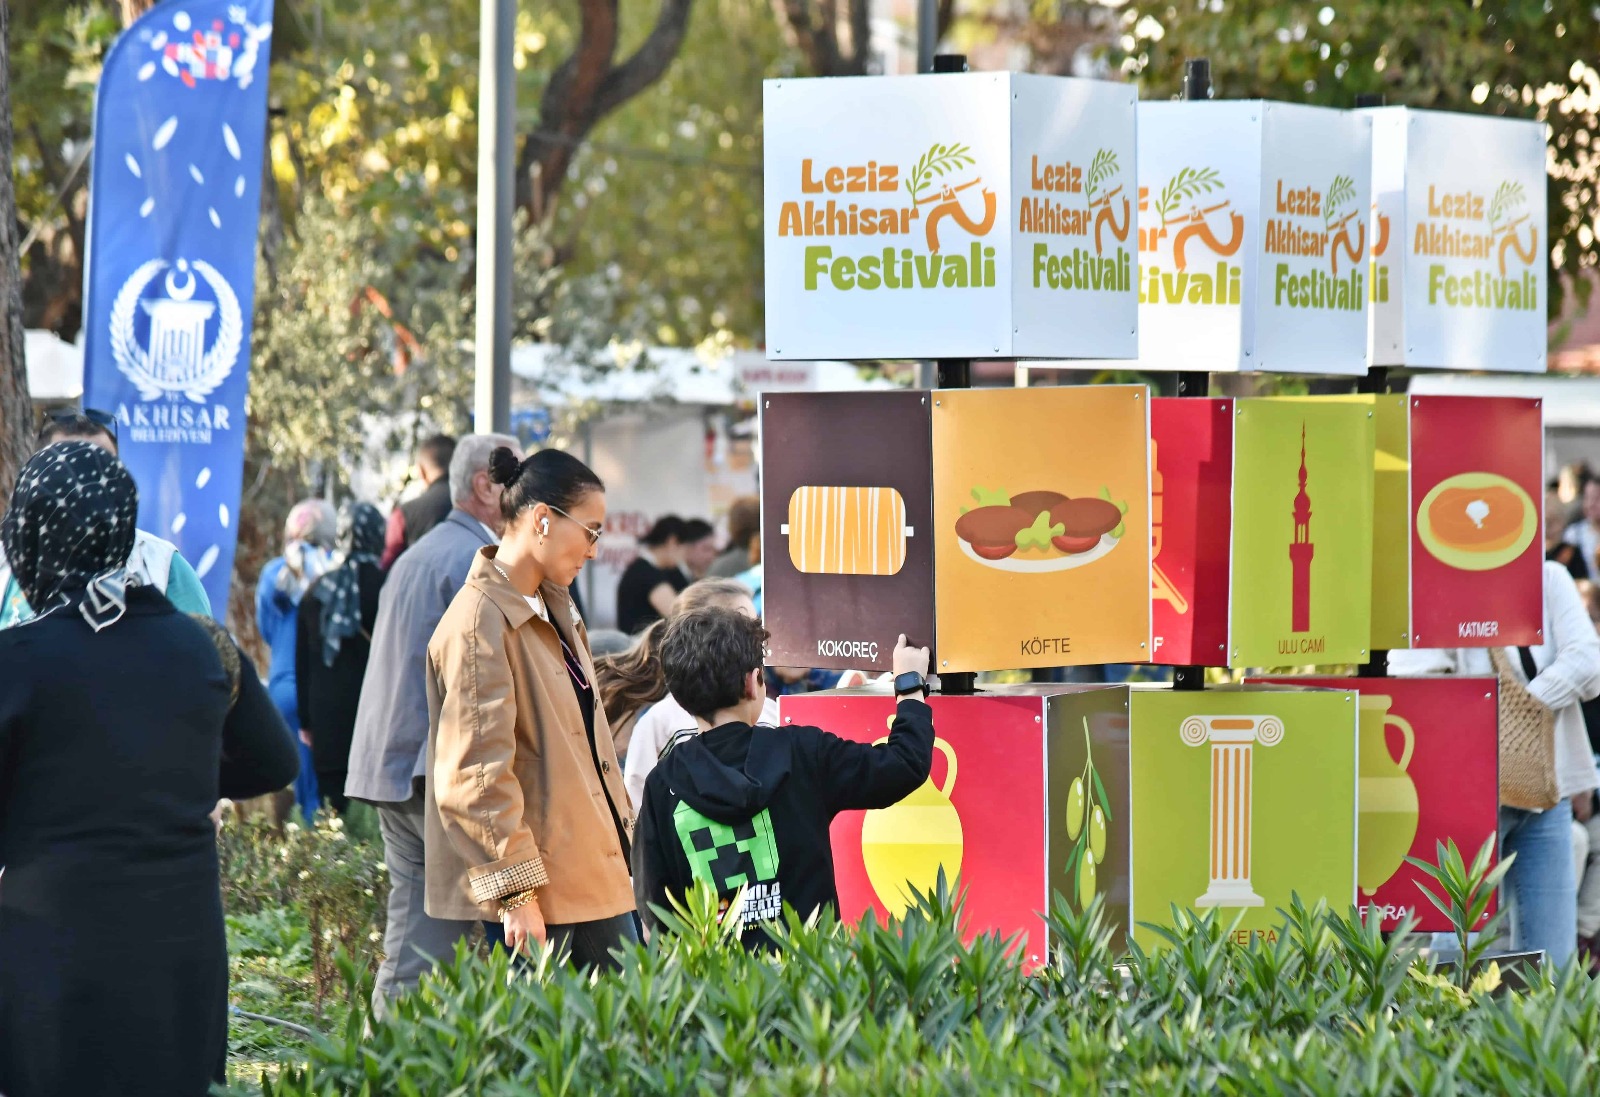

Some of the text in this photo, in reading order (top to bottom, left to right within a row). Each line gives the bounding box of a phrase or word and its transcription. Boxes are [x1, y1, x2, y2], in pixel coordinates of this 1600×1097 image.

[802, 158, 899, 194] Leziz
[1031, 154, 1082, 195] Leziz
[1019, 197, 1092, 236] Akhisar
[1276, 179, 1321, 217] Leziz
[1428, 184, 1484, 221] Leziz
[778, 199, 920, 237] Akhisar
[1265, 219, 1329, 258] Akhisar
[1414, 222, 1497, 259] Akhisar
[804, 242, 996, 291] Festivali
[1032, 243, 1131, 292] Festivali
[1275, 263, 1363, 312] Festivali
[1428, 264, 1537, 312] Festivali
[1021, 637, 1071, 656] KÖFTE
[1278, 639, 1298, 655] ULU
[1458, 620, 1499, 638] KATMER
[817, 639, 879, 662] KOKOREÇ
